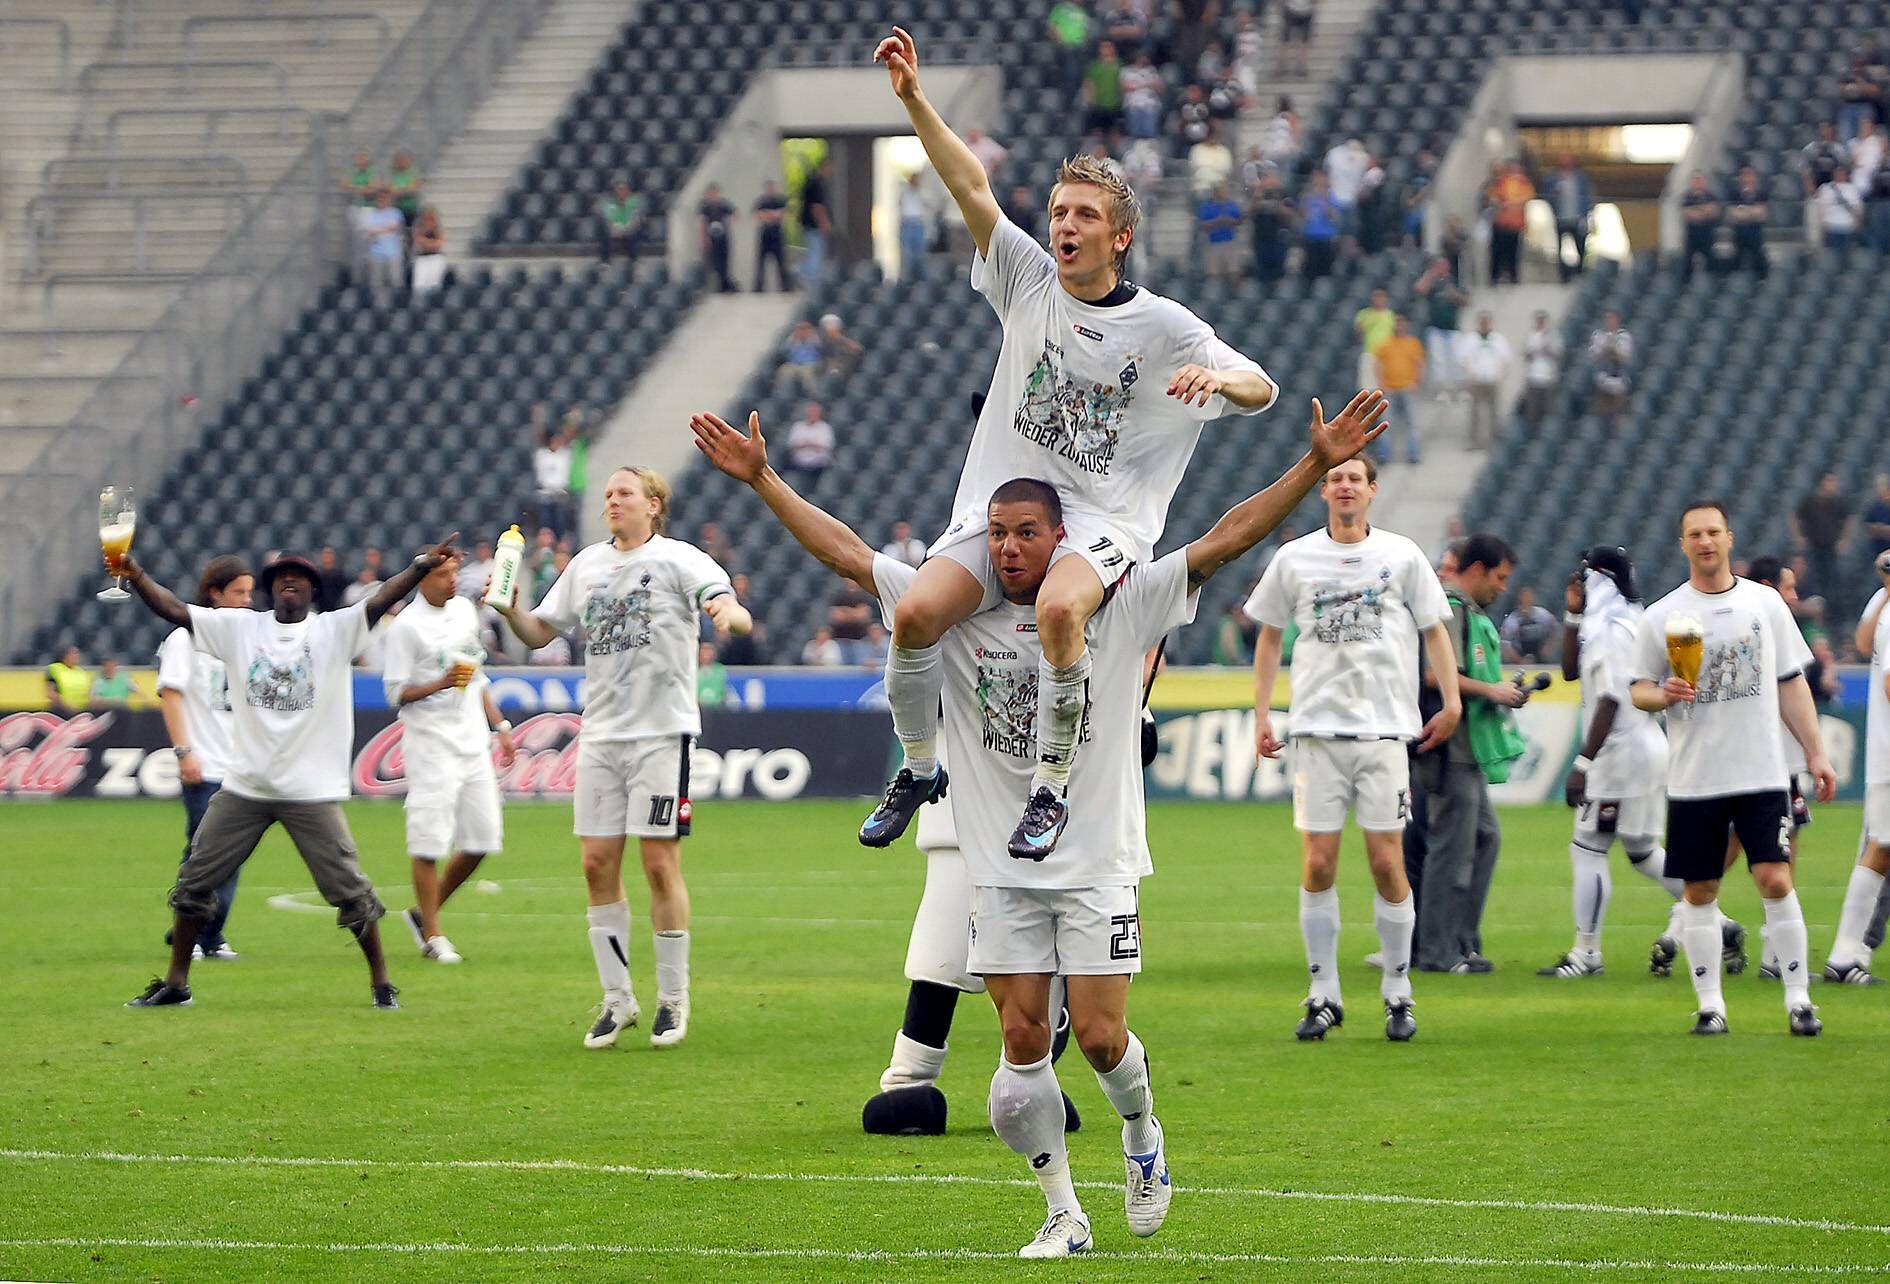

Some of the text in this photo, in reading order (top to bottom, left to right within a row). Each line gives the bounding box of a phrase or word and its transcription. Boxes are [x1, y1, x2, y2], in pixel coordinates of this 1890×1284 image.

[1013, 413, 1059, 451] WIEDER
[983, 727, 1029, 759] WIEDER
[1156, 710, 1293, 798] JEVE
[689, 747, 812, 799] ero
[648, 795, 674, 825] 10
